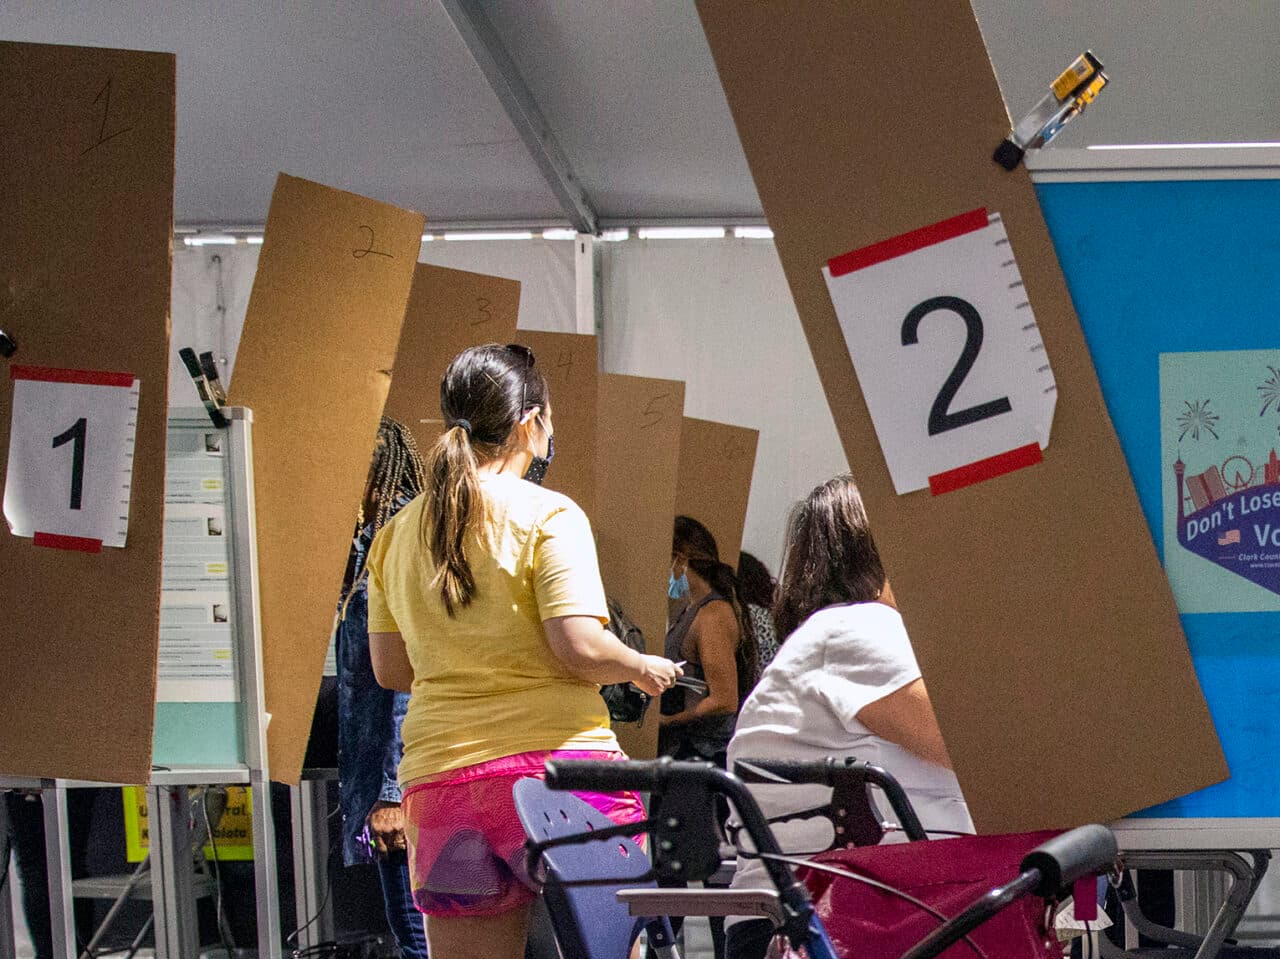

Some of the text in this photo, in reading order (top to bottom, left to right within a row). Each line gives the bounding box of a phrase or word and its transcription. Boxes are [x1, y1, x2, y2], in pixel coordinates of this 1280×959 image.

[352, 225, 394, 259] 2
[470, 297, 492, 326] 3
[556, 351, 574, 381] 4
[900, 295, 1013, 437] 2
[639, 393, 670, 430] 5
[52, 417, 88, 511] 1
[1186, 502, 1235, 542] Don't
[1238, 553, 1258, 561] Clark
